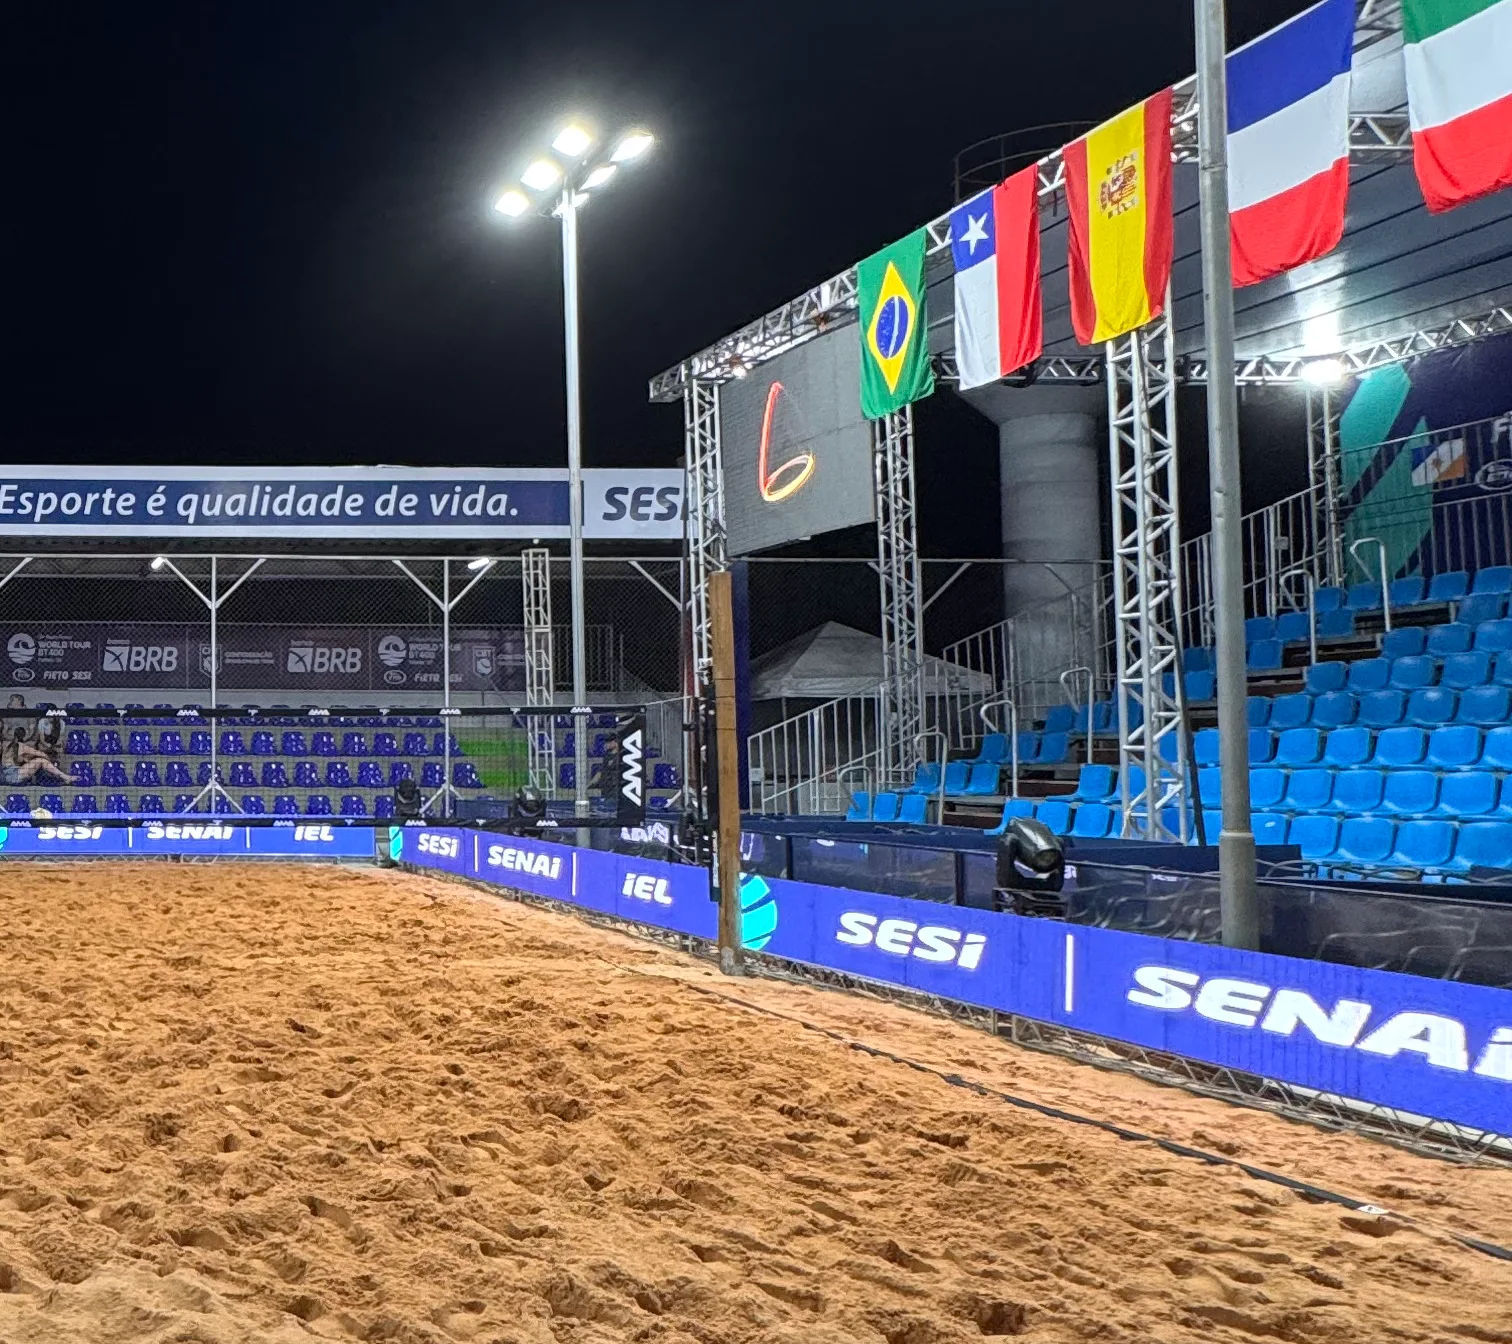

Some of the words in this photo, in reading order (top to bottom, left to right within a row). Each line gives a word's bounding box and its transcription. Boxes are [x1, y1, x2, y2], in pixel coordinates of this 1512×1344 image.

[146, 486, 166, 516] é
[177, 485, 364, 524] qualidade
[375, 485, 419, 516] de
[430, 485, 519, 517] vida.
[130, 647, 178, 671] BRB
[314, 648, 362, 673] BRB
